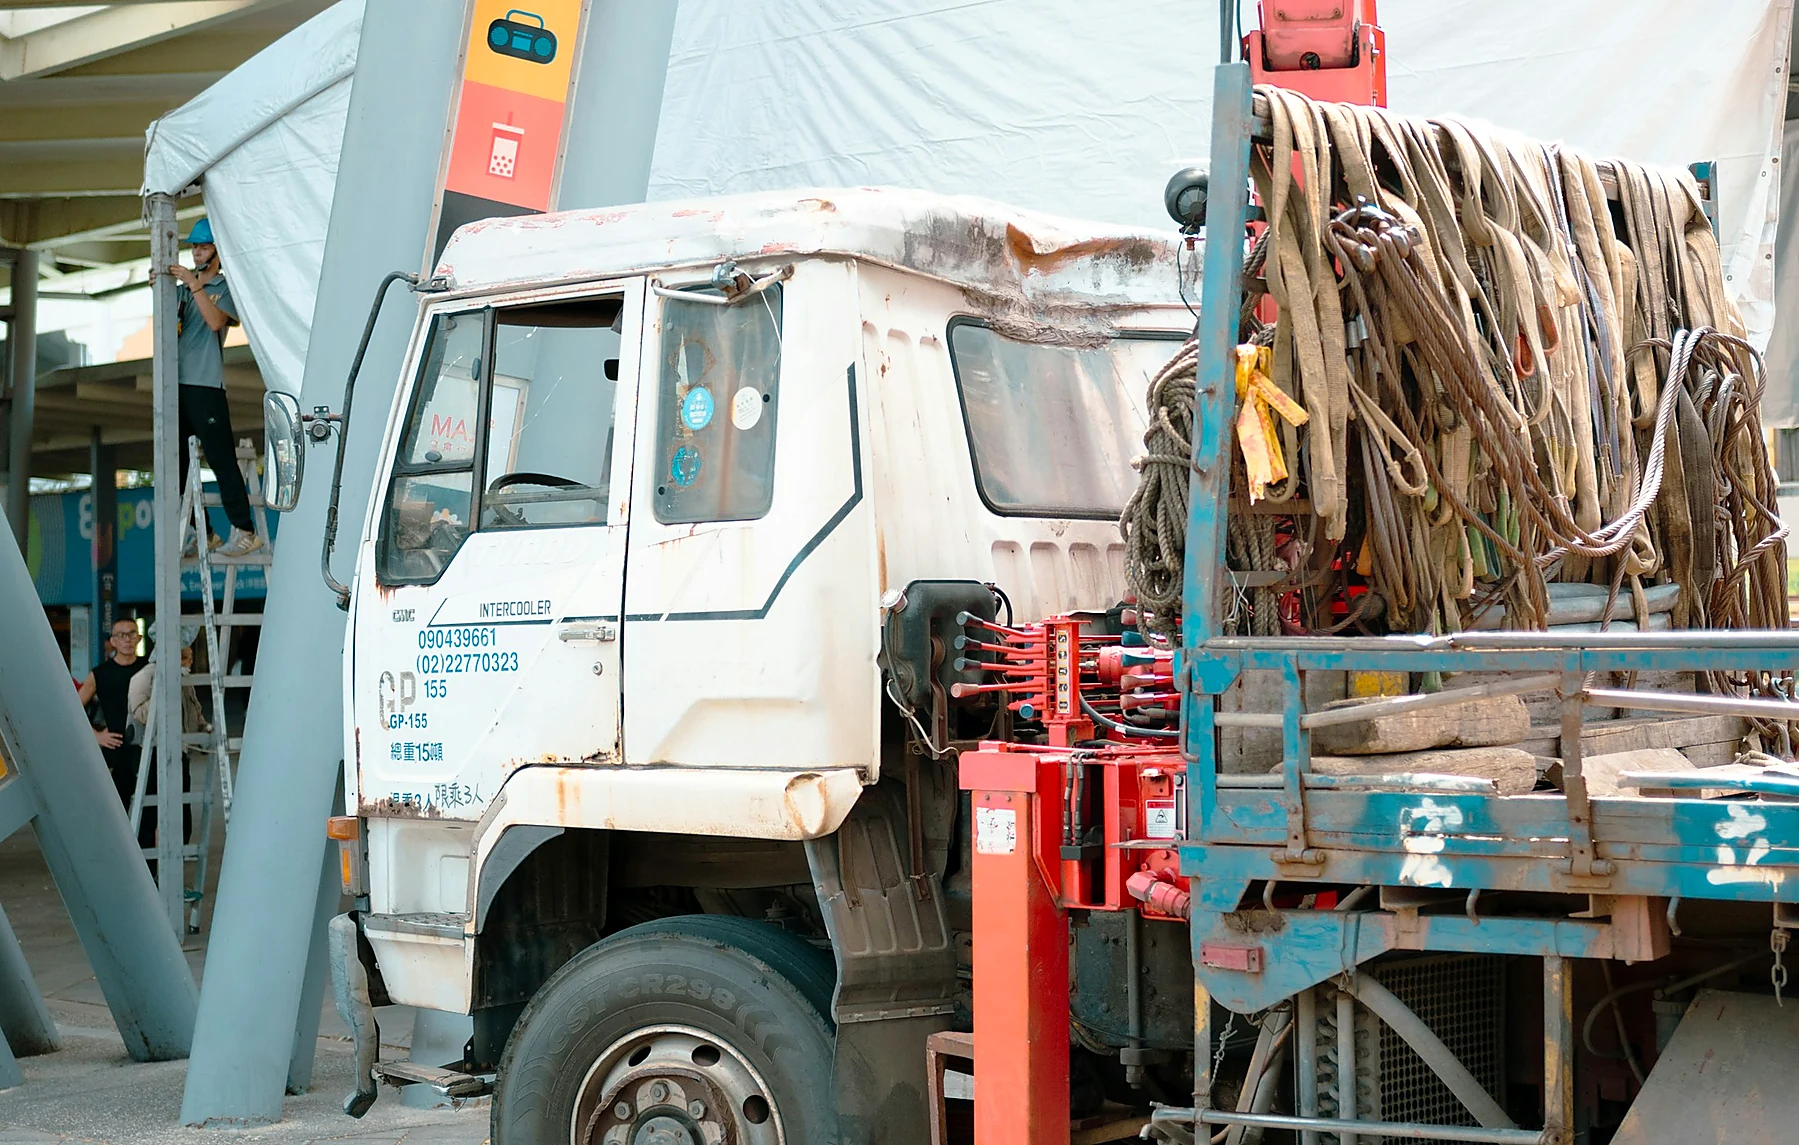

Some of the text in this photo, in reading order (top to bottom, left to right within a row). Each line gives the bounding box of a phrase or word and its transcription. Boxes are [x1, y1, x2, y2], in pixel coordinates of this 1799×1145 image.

[431, 413, 474, 442] MA
[478, 599, 552, 618] INTERCOOLER
[418, 627, 496, 649] 090439661
[416, 651, 519, 674] (02)22770323
[424, 679, 447, 699] 155
[434, 782, 484, 809] 限乘3人
[548, 979, 612, 1055] CST
